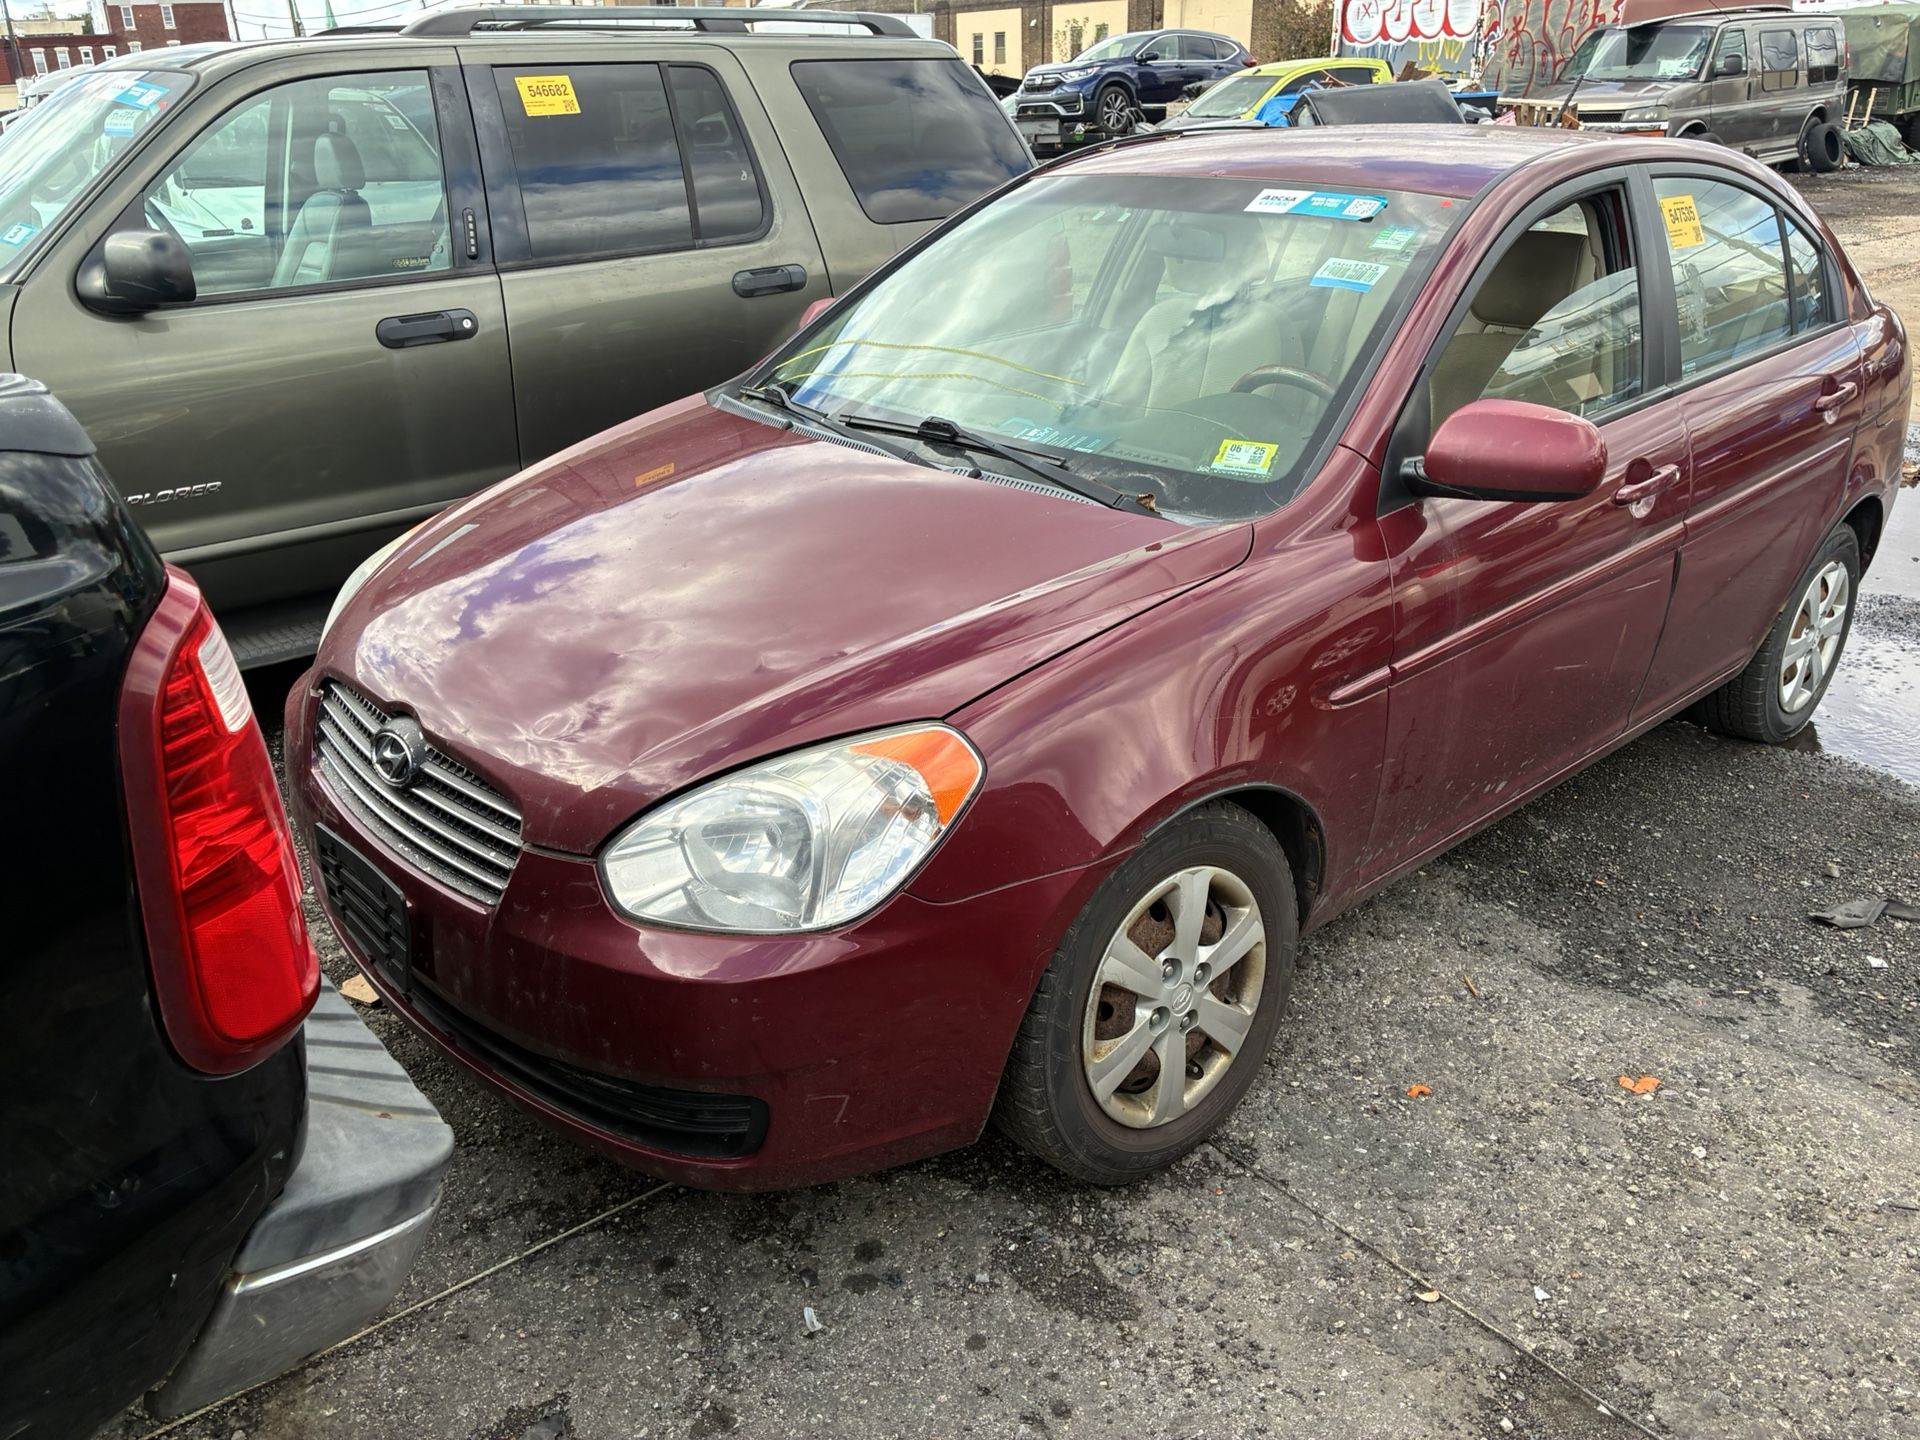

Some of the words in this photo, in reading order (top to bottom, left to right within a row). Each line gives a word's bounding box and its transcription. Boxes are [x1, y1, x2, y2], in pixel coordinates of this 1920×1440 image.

[527, 83, 570, 98] 546682
[1253, 446, 1266, 455] 25
[123, 481, 222, 505] PLORER
